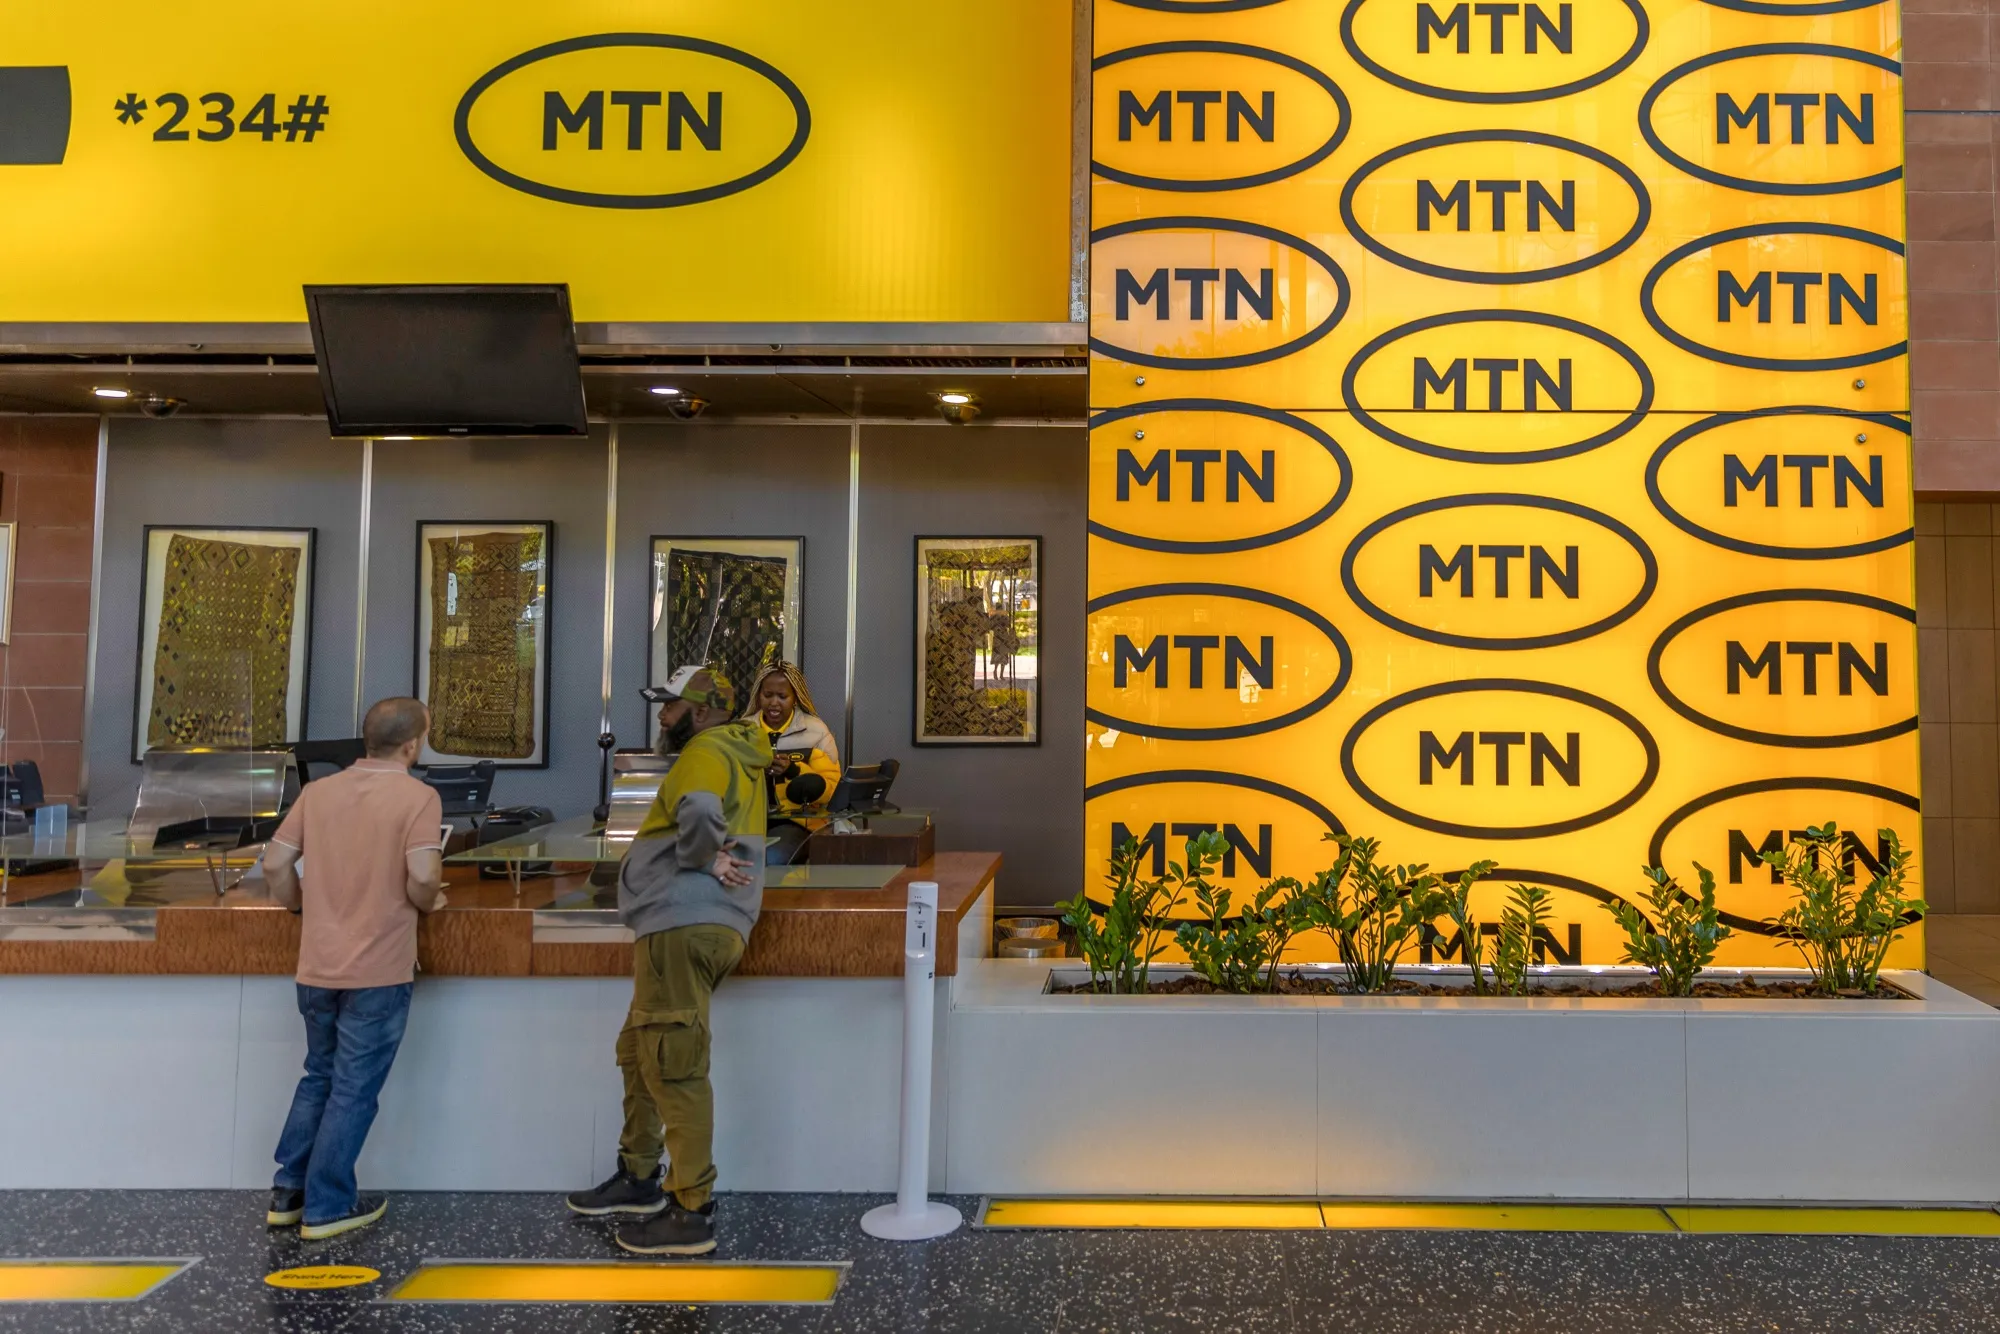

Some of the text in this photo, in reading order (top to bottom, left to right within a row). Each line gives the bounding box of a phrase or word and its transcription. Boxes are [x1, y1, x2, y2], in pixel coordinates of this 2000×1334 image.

[1417, 3, 1573, 54] MTN
[543, 91, 722, 151] MTN
[1119, 90, 1275, 142] MTN
[1716, 93, 1874, 145] MTN
[1417, 180, 1575, 232] MTN
[1116, 268, 1273, 320] MTN
[1718, 271, 1878, 325] MTN
[1414, 357, 1573, 411] MTN
[1117, 449, 1275, 502] MTN
[1724, 454, 1884, 508] MTN
[1420, 545, 1579, 598] MTN
[1114, 635, 1273, 689] MTN
[1727, 641, 1888, 696] MTN
[1420, 731, 1580, 786] MTN
